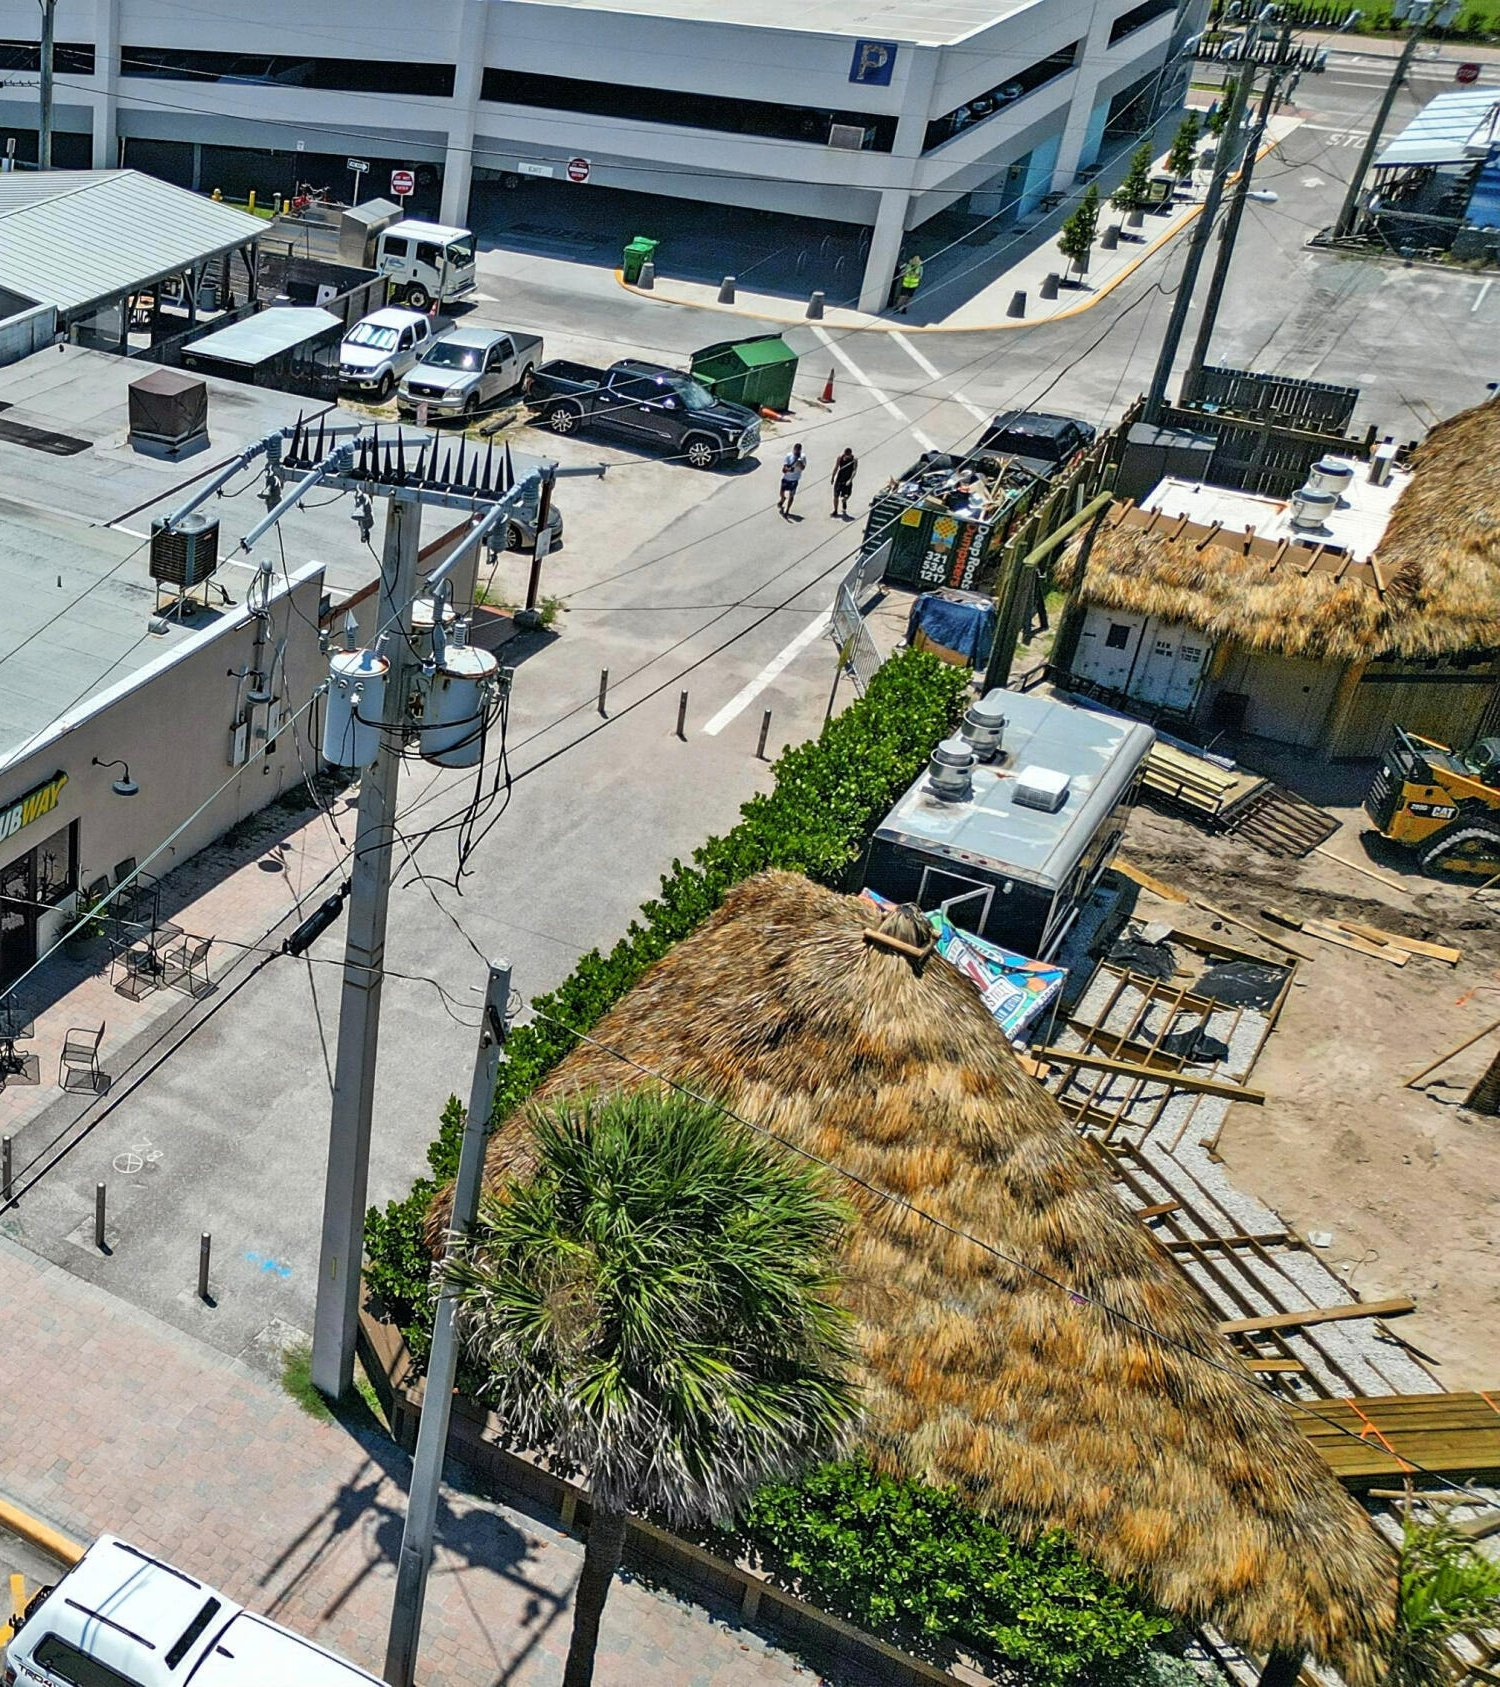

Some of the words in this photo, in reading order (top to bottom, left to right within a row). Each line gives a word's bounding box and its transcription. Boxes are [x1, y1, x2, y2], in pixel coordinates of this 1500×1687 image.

[1458, 68, 1478, 79] STOP
[925, 551, 948, 564] 321
[950, 523, 978, 587] Dumpsters
[922, 560, 945, 574] 536
[920, 570, 947, 584] 1217
[1431, 806, 1456, 819] CAT
